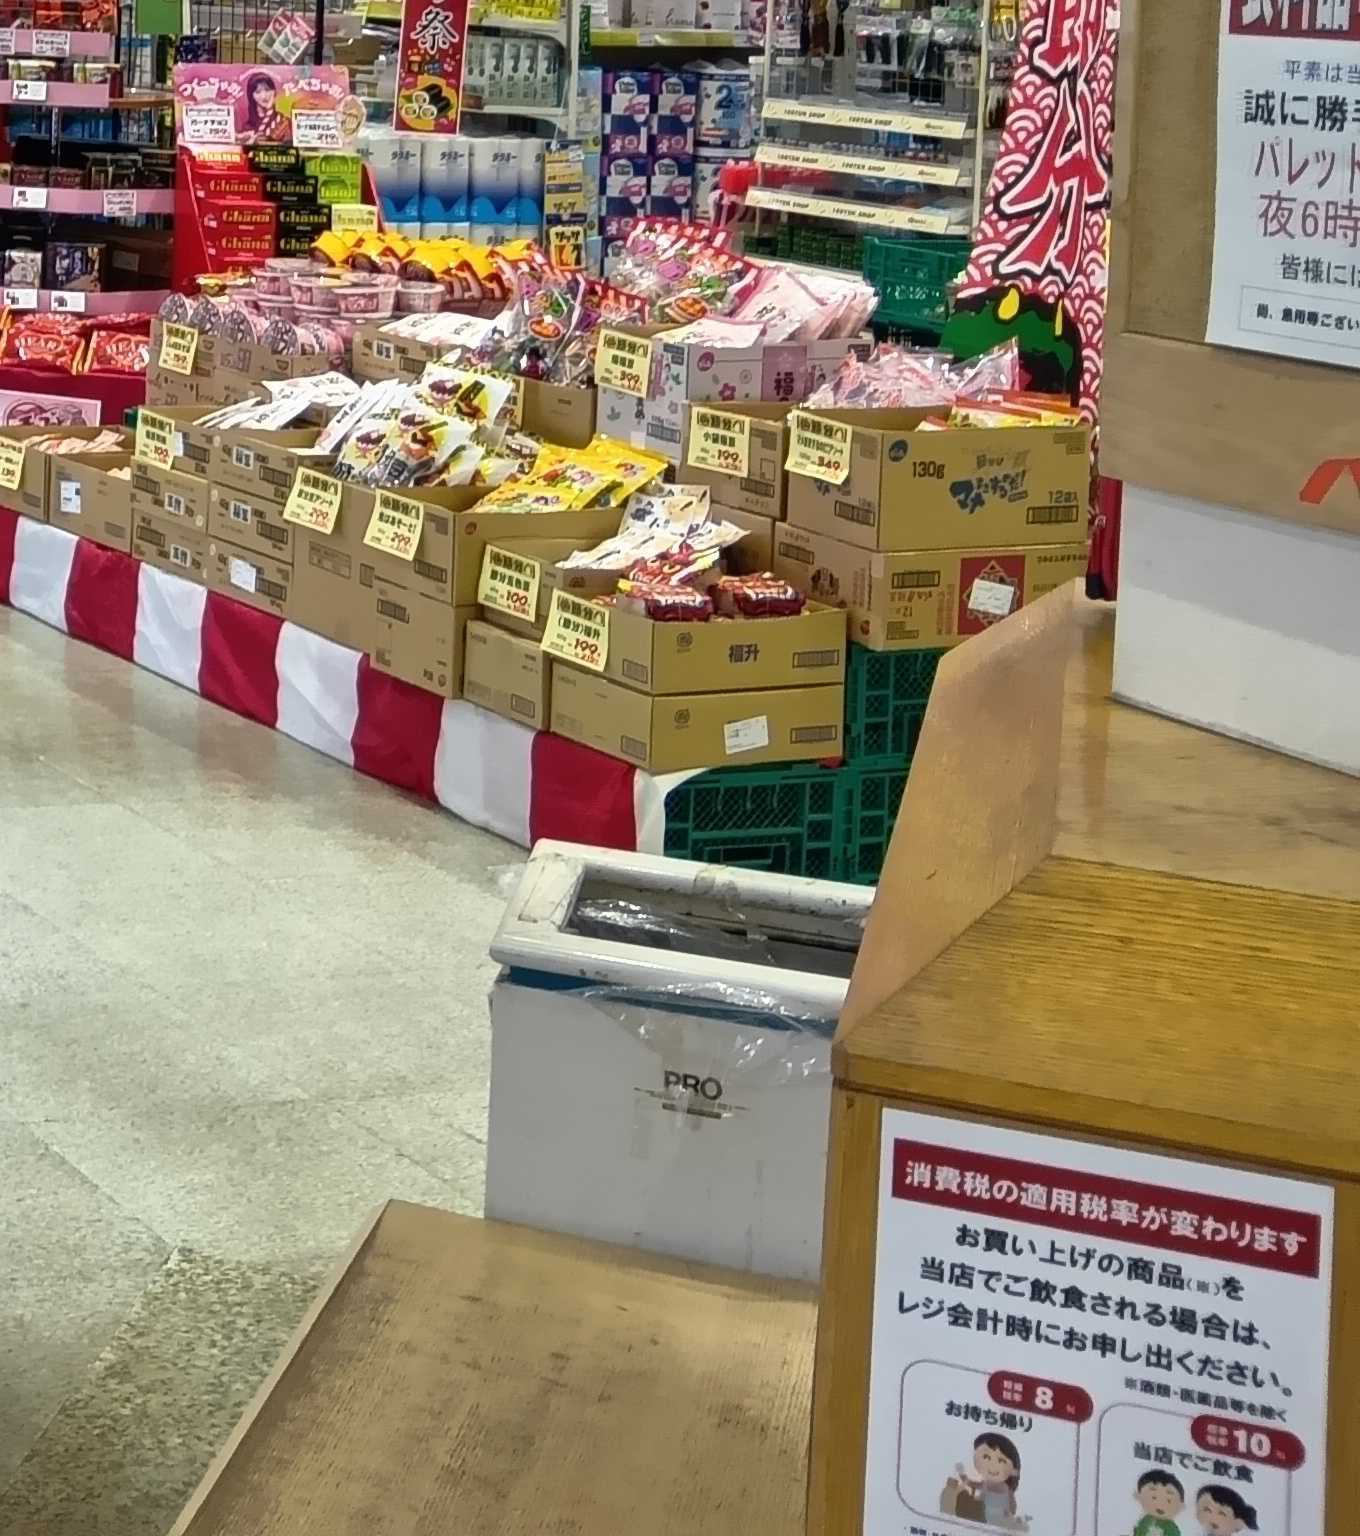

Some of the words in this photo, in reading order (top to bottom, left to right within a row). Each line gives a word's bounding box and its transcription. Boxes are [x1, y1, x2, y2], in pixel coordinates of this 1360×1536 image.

[1243, 88, 1360, 132] 誠に勝
[209, 177, 258, 192] Ghana
[266, 179, 314, 194] Ghana
[222, 209, 271, 223] Ghana
[279, 210, 328, 224] Ghana
[1258, 190, 1360, 248] 夜6時
[221, 235, 270, 250] Ghana
[279, 236, 310, 250] Gha
[912, 460, 945, 479] 130g
[728, 643, 760, 664] 福升
[663, 1070, 723, 1101] PRO
[905, 1159, 1309, 1258] 消費税の適用税率が変わります
[918, 1255, 1274, 1350] 当店でご飲食される場合は、
[896, 1290, 1294, 1398] レジ会計時にお申し出ください。
[1034, 1385, 1055, 1411] 8
[944, 1399, 1035, 1434] お持ち帰り
[1232, 1427, 1273, 1459] 10
[1133, 1440, 1256, 1484] 当店でご飲食
